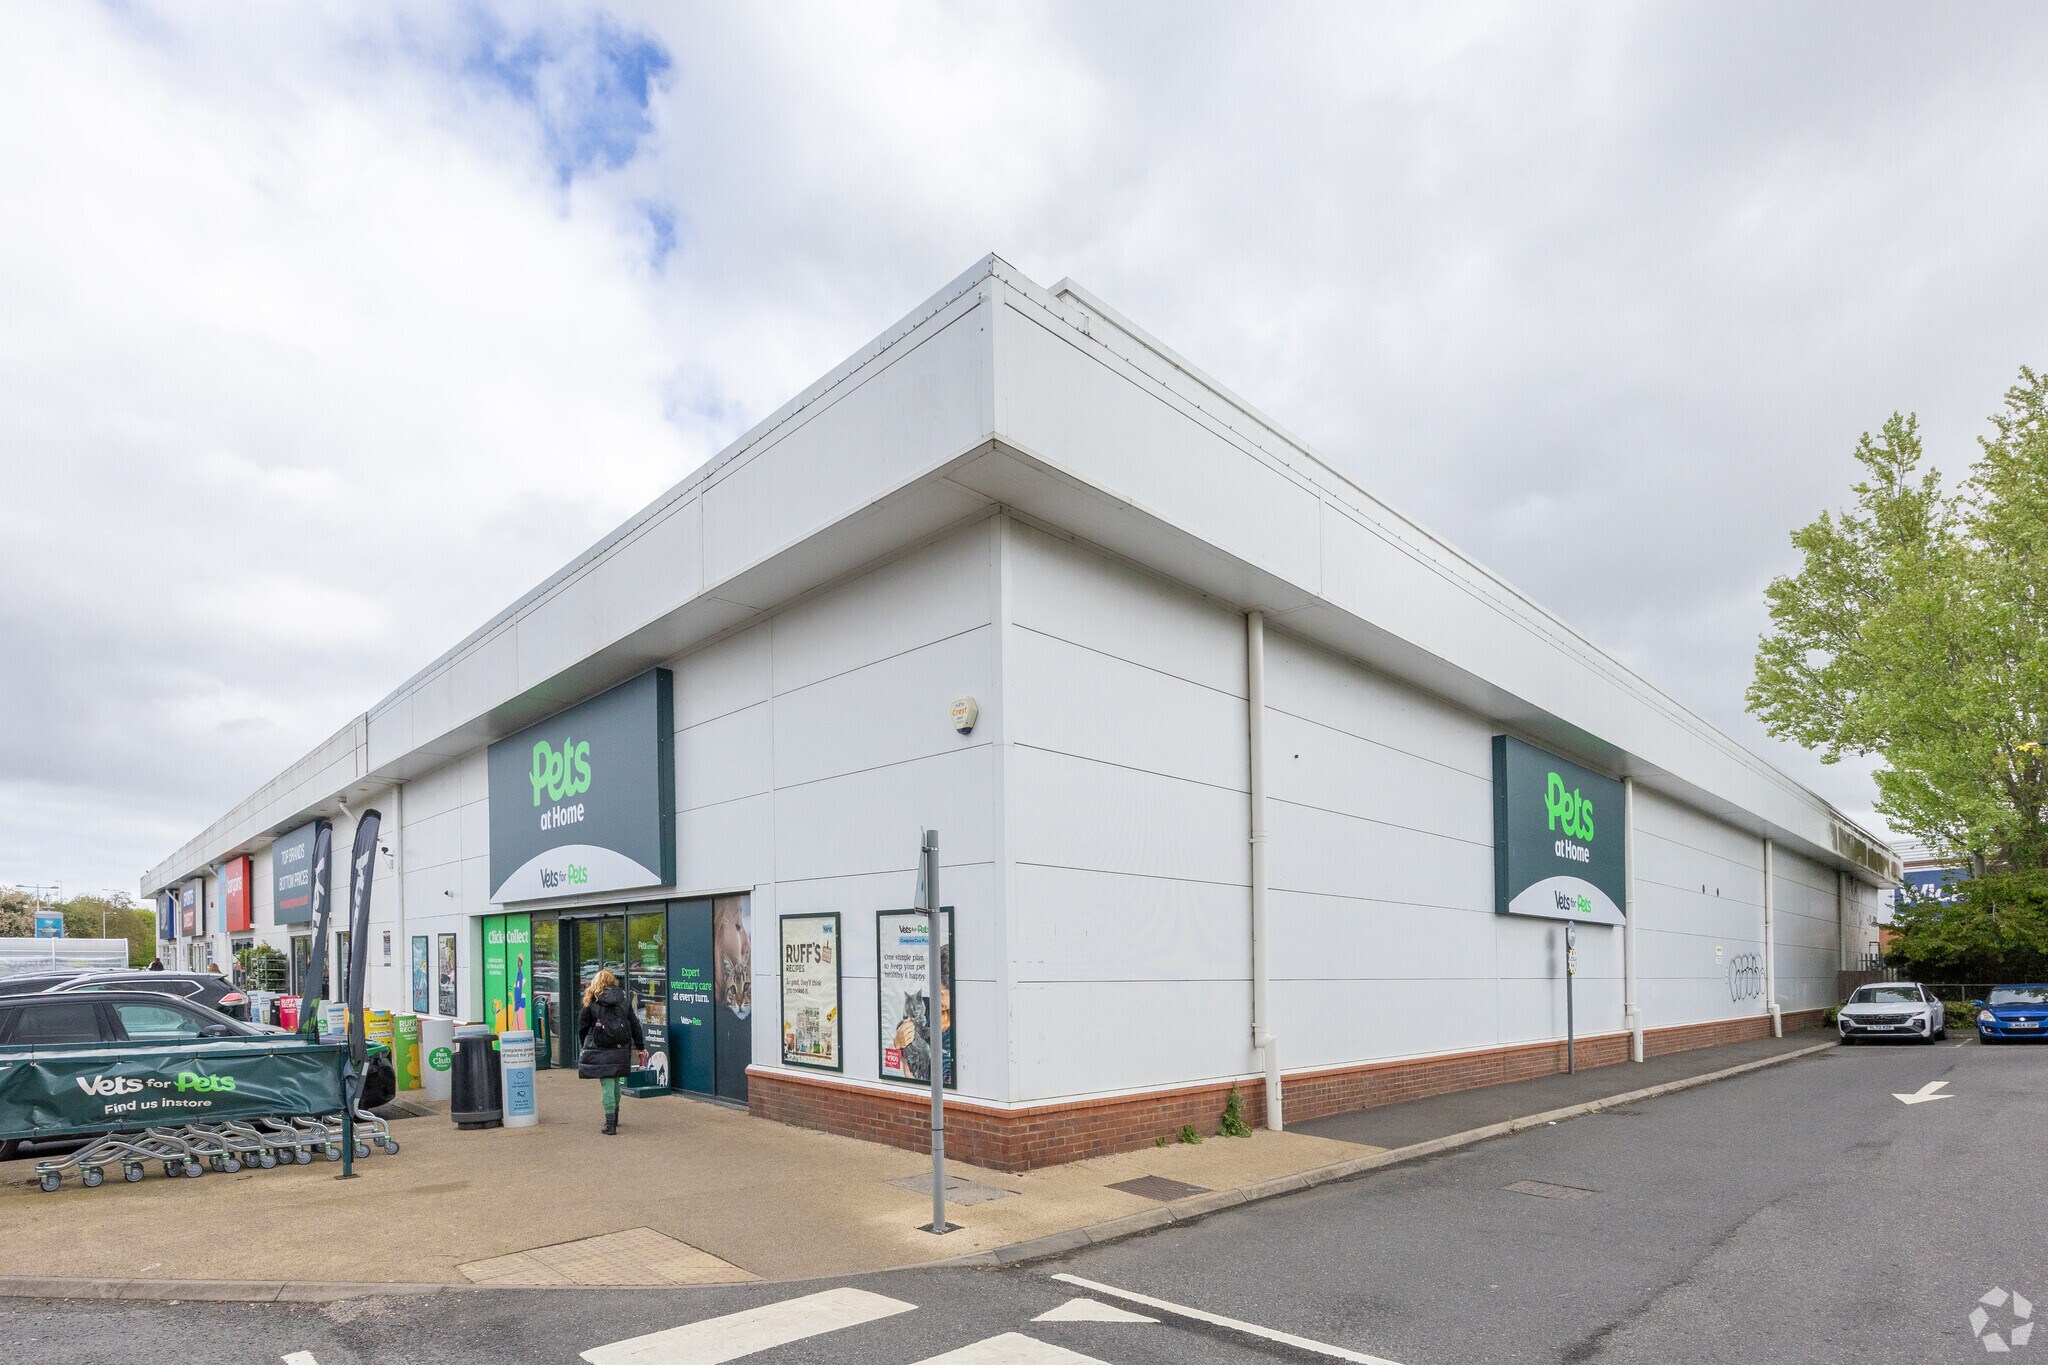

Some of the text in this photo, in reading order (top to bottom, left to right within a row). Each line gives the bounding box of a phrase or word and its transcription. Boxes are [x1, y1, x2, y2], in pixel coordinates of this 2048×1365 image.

[529, 736, 592, 807] Pets
[1544, 771, 1595, 842] Pets
[540, 803, 585, 831] at Home
[281, 843, 305, 866] TOP BRANDS
[1554, 839, 1590, 863] at Home
[279, 869, 309, 891] BOTTOM PRICES
[540, 863, 588, 889] Vets for Pets
[1554, 890, 1570, 911] Vets
[1577, 894, 1592, 914] Pets
[488, 929, 503, 945] Click
[506, 929, 529, 944] Collect
[899, 925, 912, 934] Vets
[785, 942, 822, 964] RUFF'S
[895, 953, 911, 962] simple
[912, 954, 925, 962] plan
[681, 968, 700, 979] Expert
[785, 964, 805, 973] RECIPES
[890, 962, 903, 971] keep
[884, 971, 904, 980] healthy
[670, 979, 698, 992] veterinary
[698, 982, 712, 991] care
[672, 993, 710, 1004] at every turn.
[681, 1016, 690, 1025] Vets
[692, 1017, 702, 1026] Pets
[433, 1057, 451, 1065] Club
[75, 1071, 237, 1097] Vets for Pets
[104, 1097, 212, 1115] Find us instore
